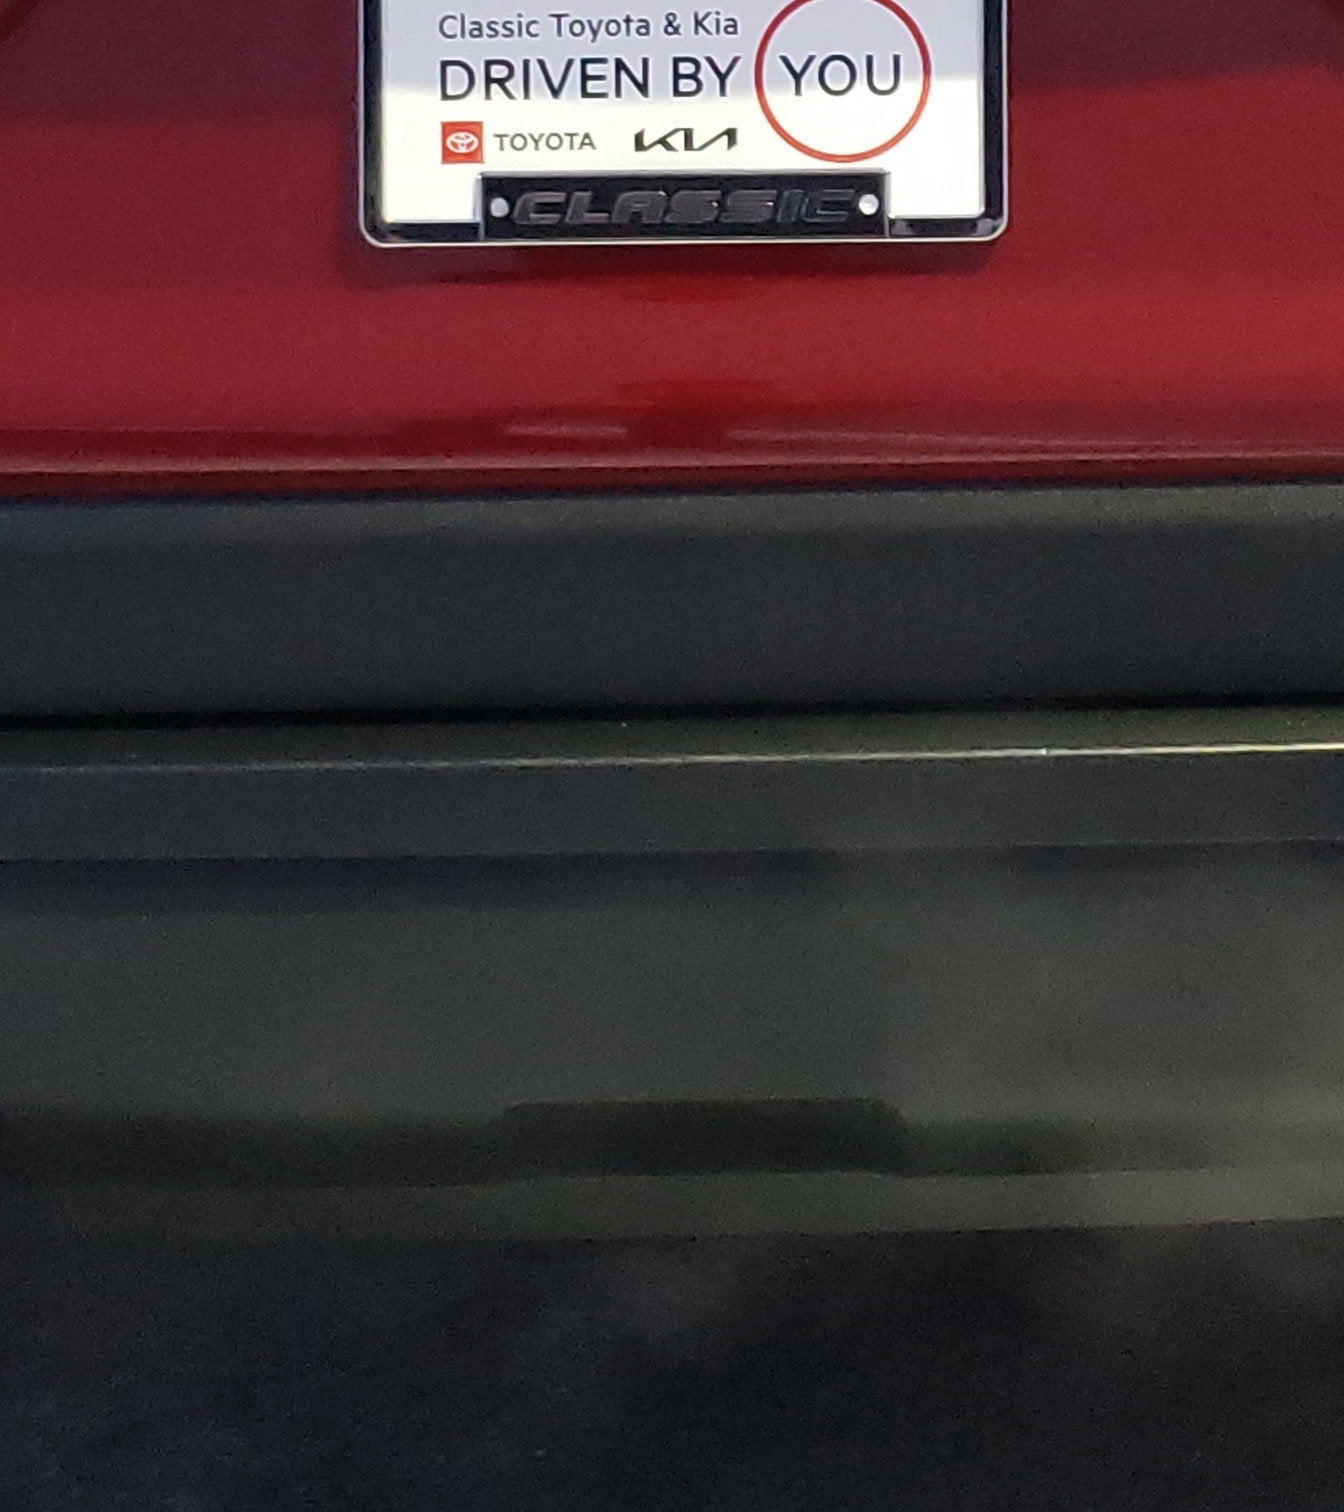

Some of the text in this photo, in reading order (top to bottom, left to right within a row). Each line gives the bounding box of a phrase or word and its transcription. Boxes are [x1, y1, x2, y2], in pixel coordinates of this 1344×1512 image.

[438, 10, 739, 43] Classic Toyota & Kia
[439, 54, 902, 101] DRIVEN BY YOU
[493, 132, 597, 151] TOYOTA
[513, 189, 855, 225] CLASSIC
